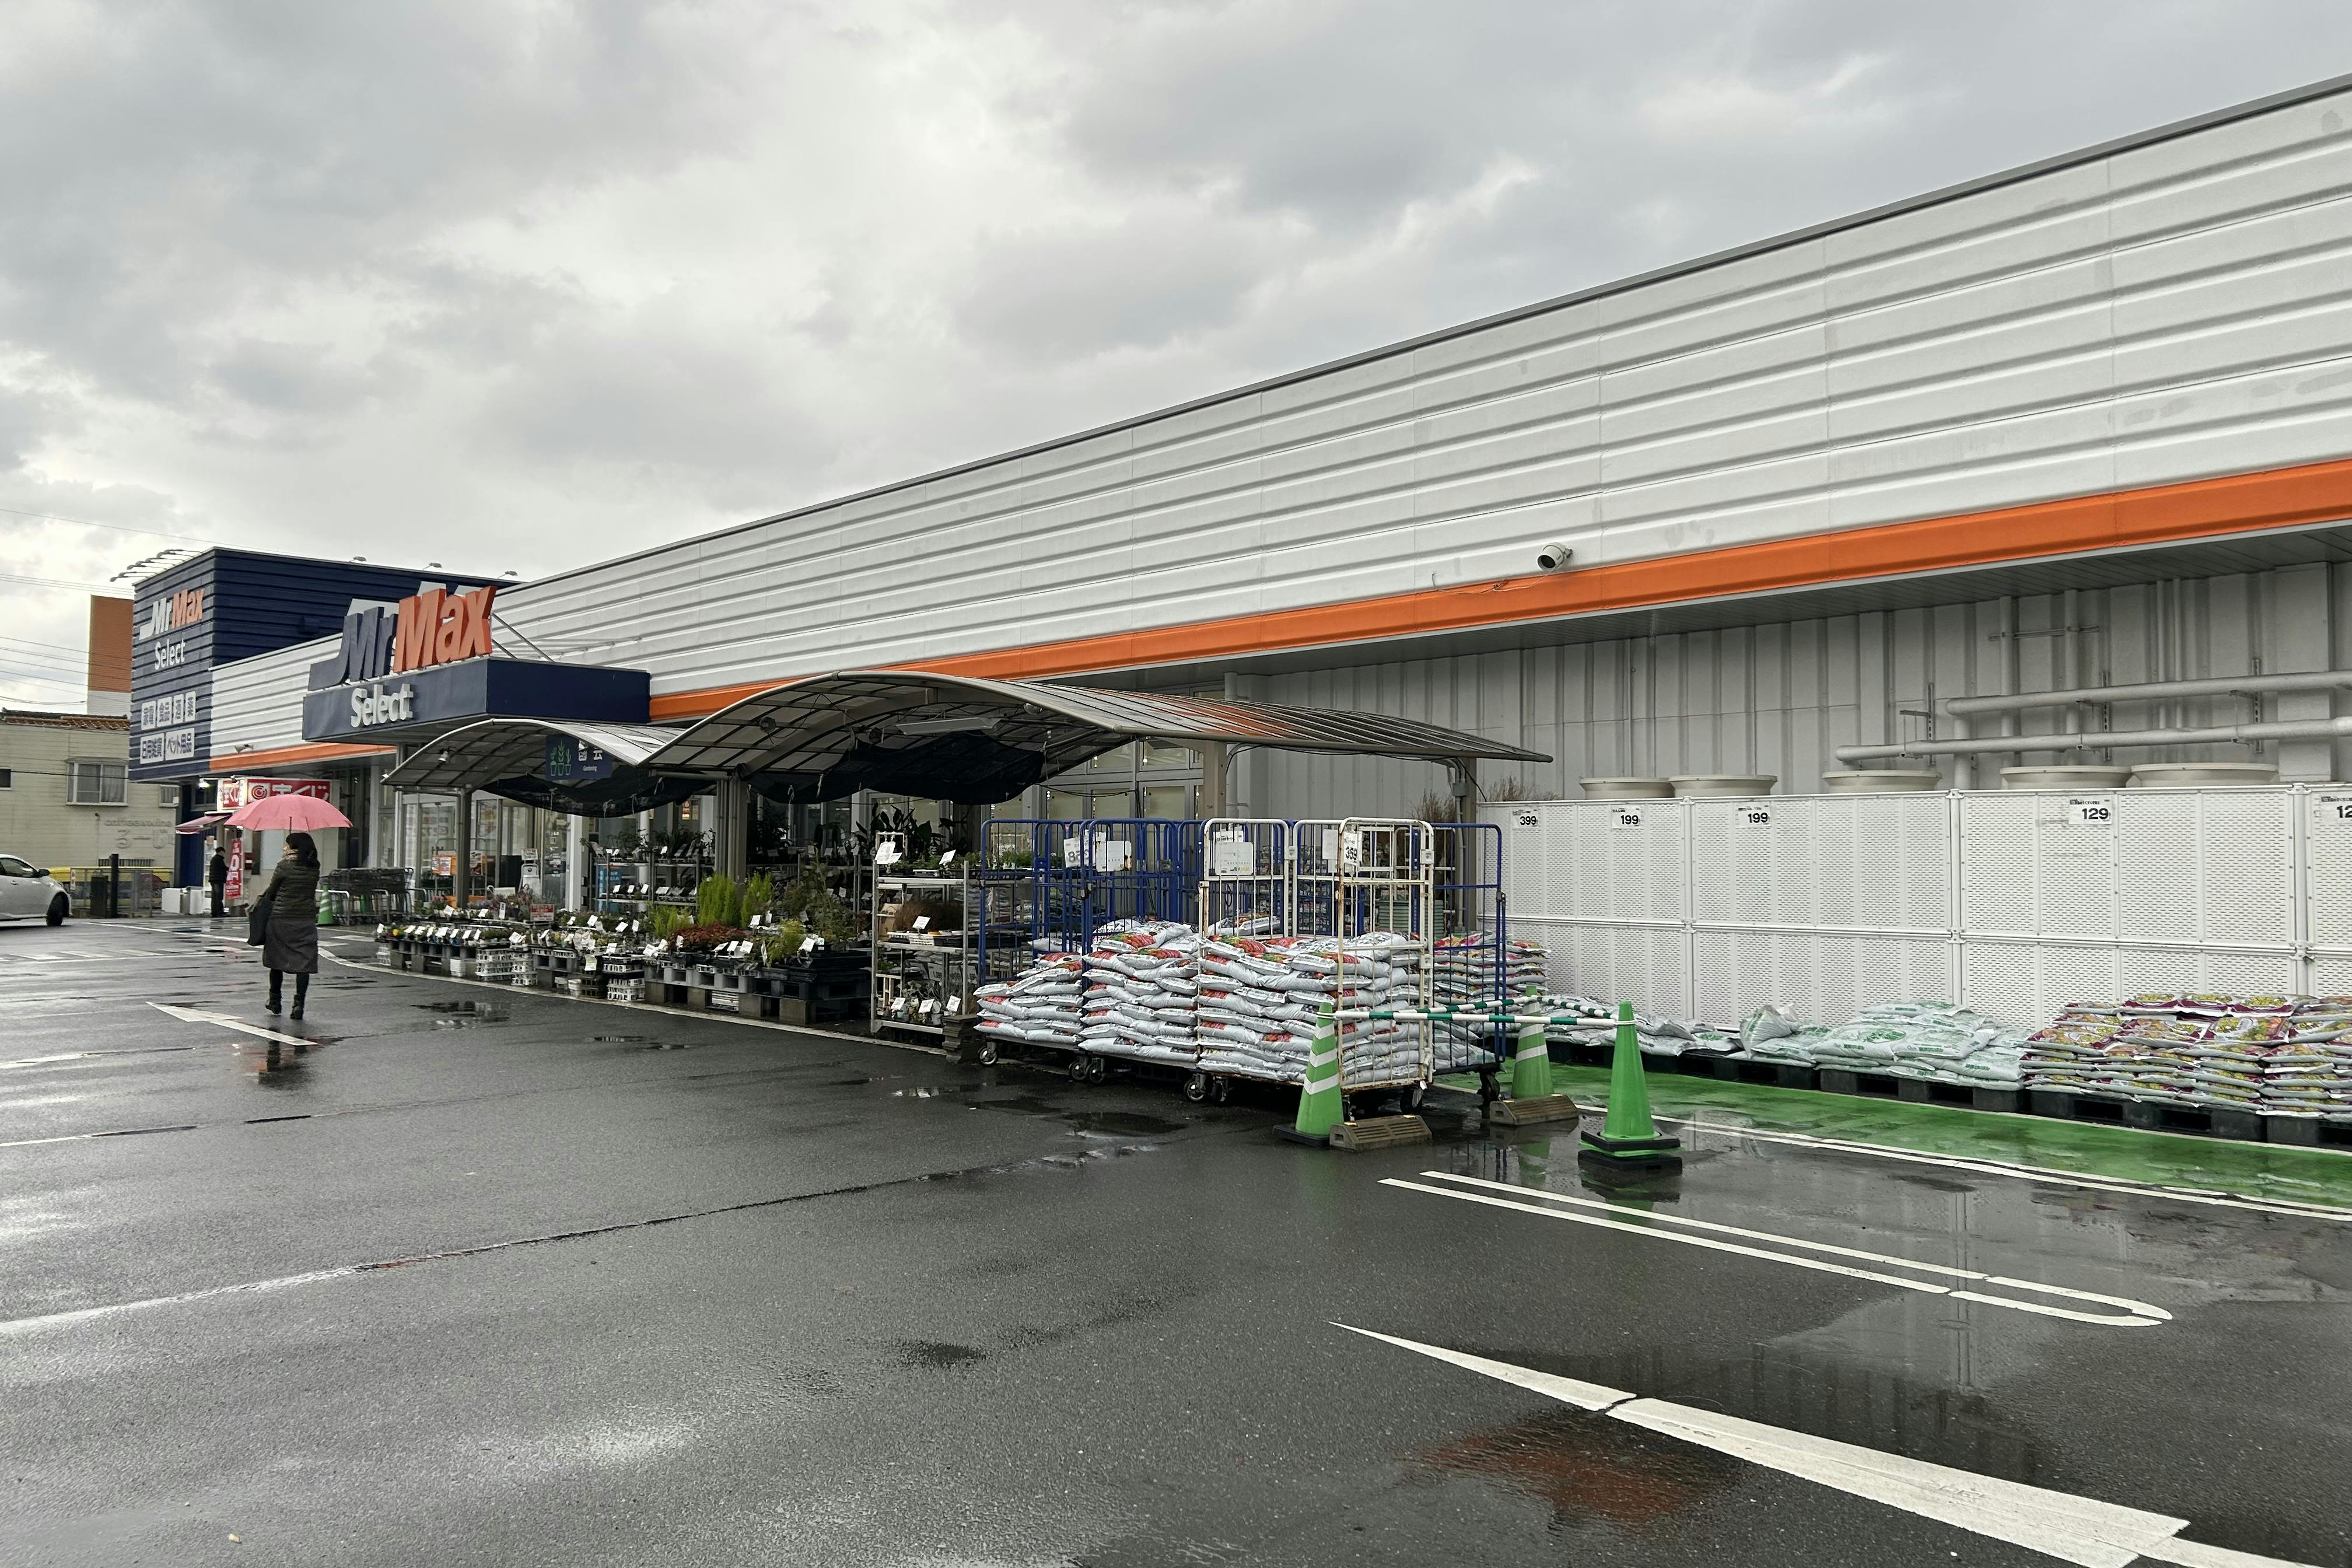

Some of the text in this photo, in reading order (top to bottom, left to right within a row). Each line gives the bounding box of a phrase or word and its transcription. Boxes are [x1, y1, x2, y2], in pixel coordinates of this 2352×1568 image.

[139, 587, 205, 640] MrMax
[308, 585, 498, 691] MrMax
[154, 639, 186, 670] Select
[351, 683, 414, 728] Select
[1520, 816, 1536, 825] 399
[1620, 815, 1639, 825] 199
[1748, 813, 1768, 823] 199
[2082, 807, 2109, 820] 129
[1345, 846, 1358, 860] 359
